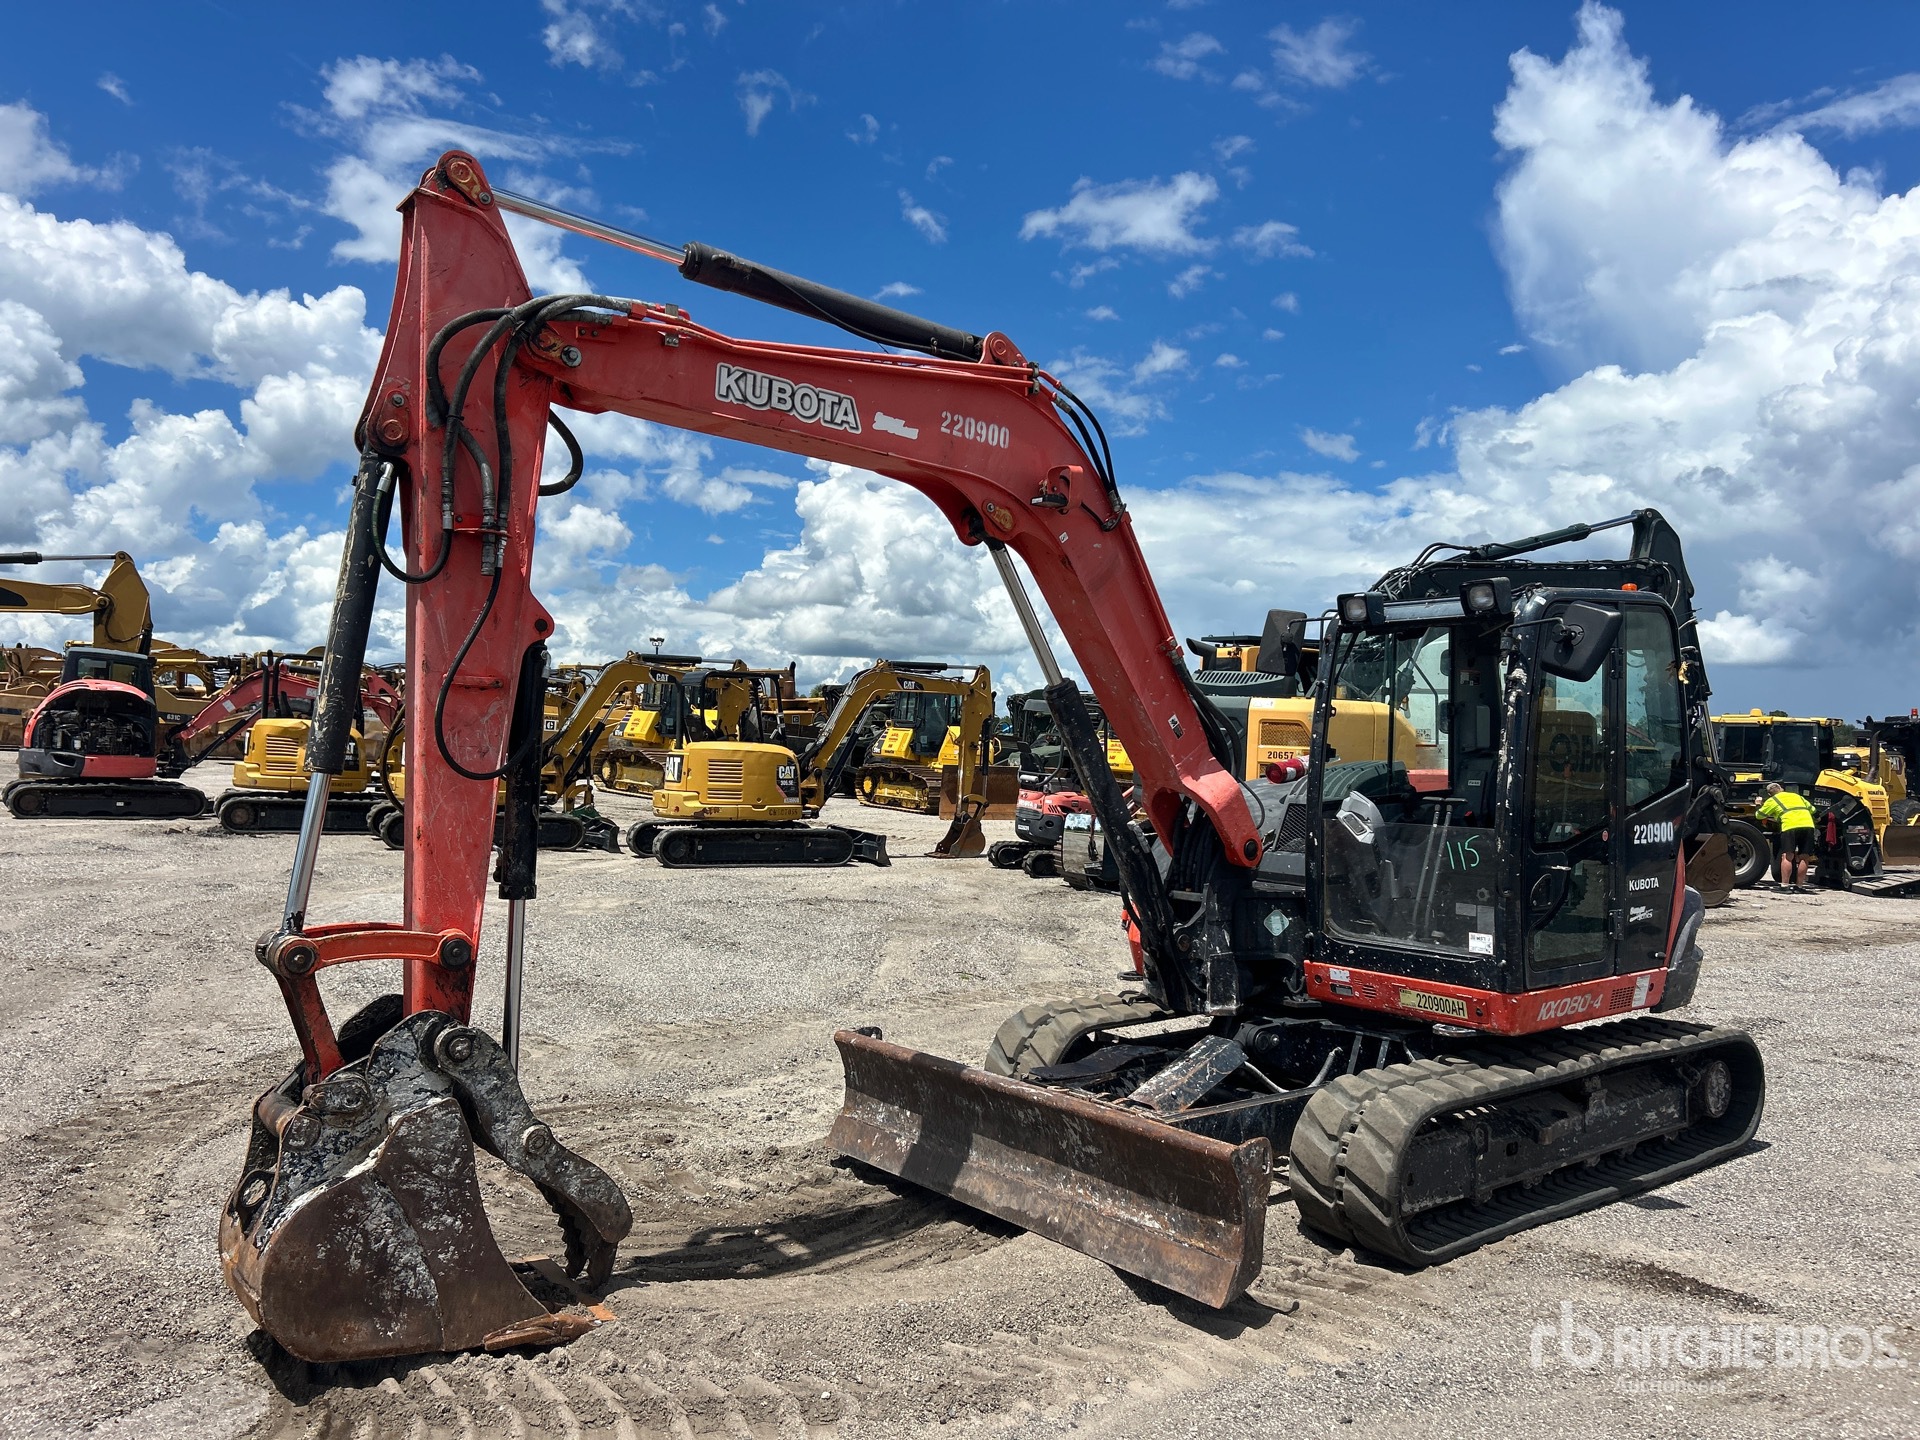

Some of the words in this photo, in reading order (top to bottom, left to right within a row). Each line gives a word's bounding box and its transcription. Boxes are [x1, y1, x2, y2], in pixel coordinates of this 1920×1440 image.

[716, 363, 861, 433] KUBOTA
[940, 410, 1010, 449] 220900
[656, 673, 669, 682] CAT
[903, 680, 916, 690] CAT
[1267, 751, 1295, 760] 20657
[778, 765, 796, 780] CAT
[1633, 821, 1674, 845] 220900
[1446, 834, 1480, 871] 115
[1628, 877, 1660, 892] KUBOTA
[1416, 992, 1466, 1017] 220900AH
[1536, 993, 1604, 1022] KX080-4
